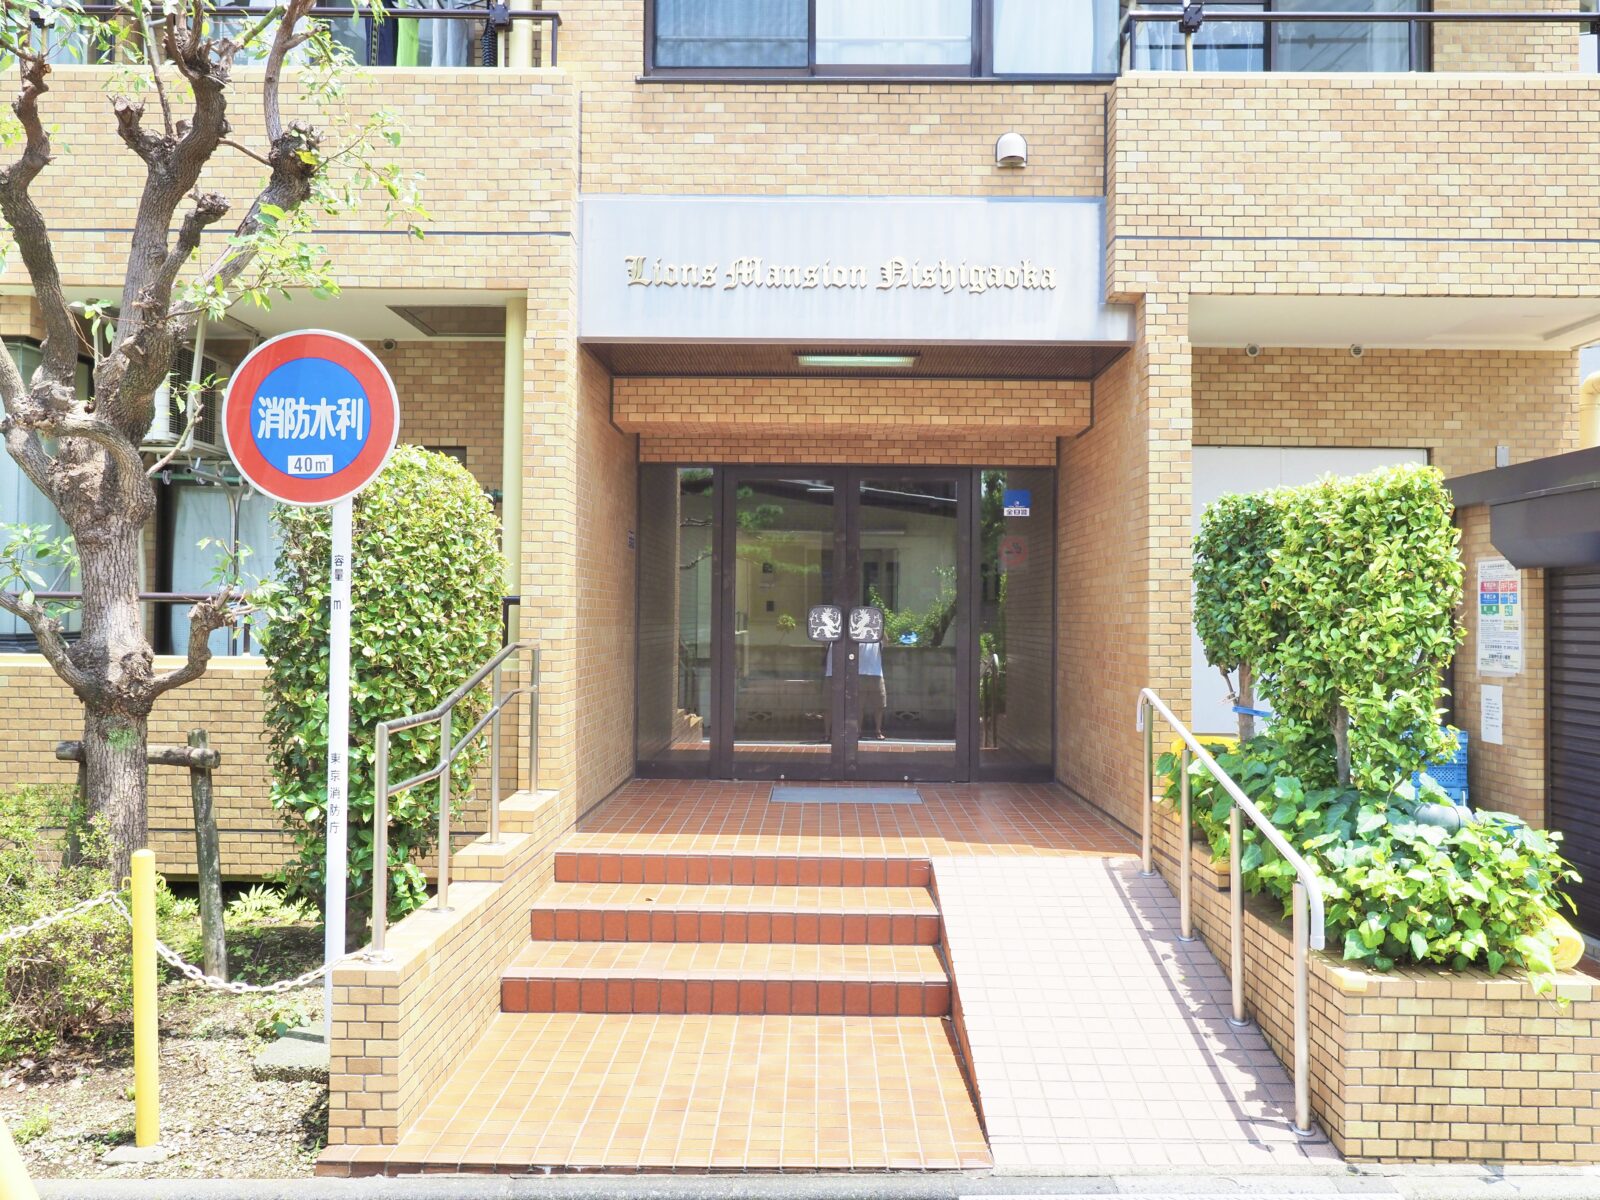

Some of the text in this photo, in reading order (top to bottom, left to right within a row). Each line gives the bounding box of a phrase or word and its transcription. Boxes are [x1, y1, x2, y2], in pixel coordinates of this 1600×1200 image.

[625, 255, 1057, 294] Lions Mansion Nishigaoka
[257, 396, 364, 441] 消防水利
[334, 555, 344, 582] 容量
[329, 753, 341, 834] 東京消防庁
